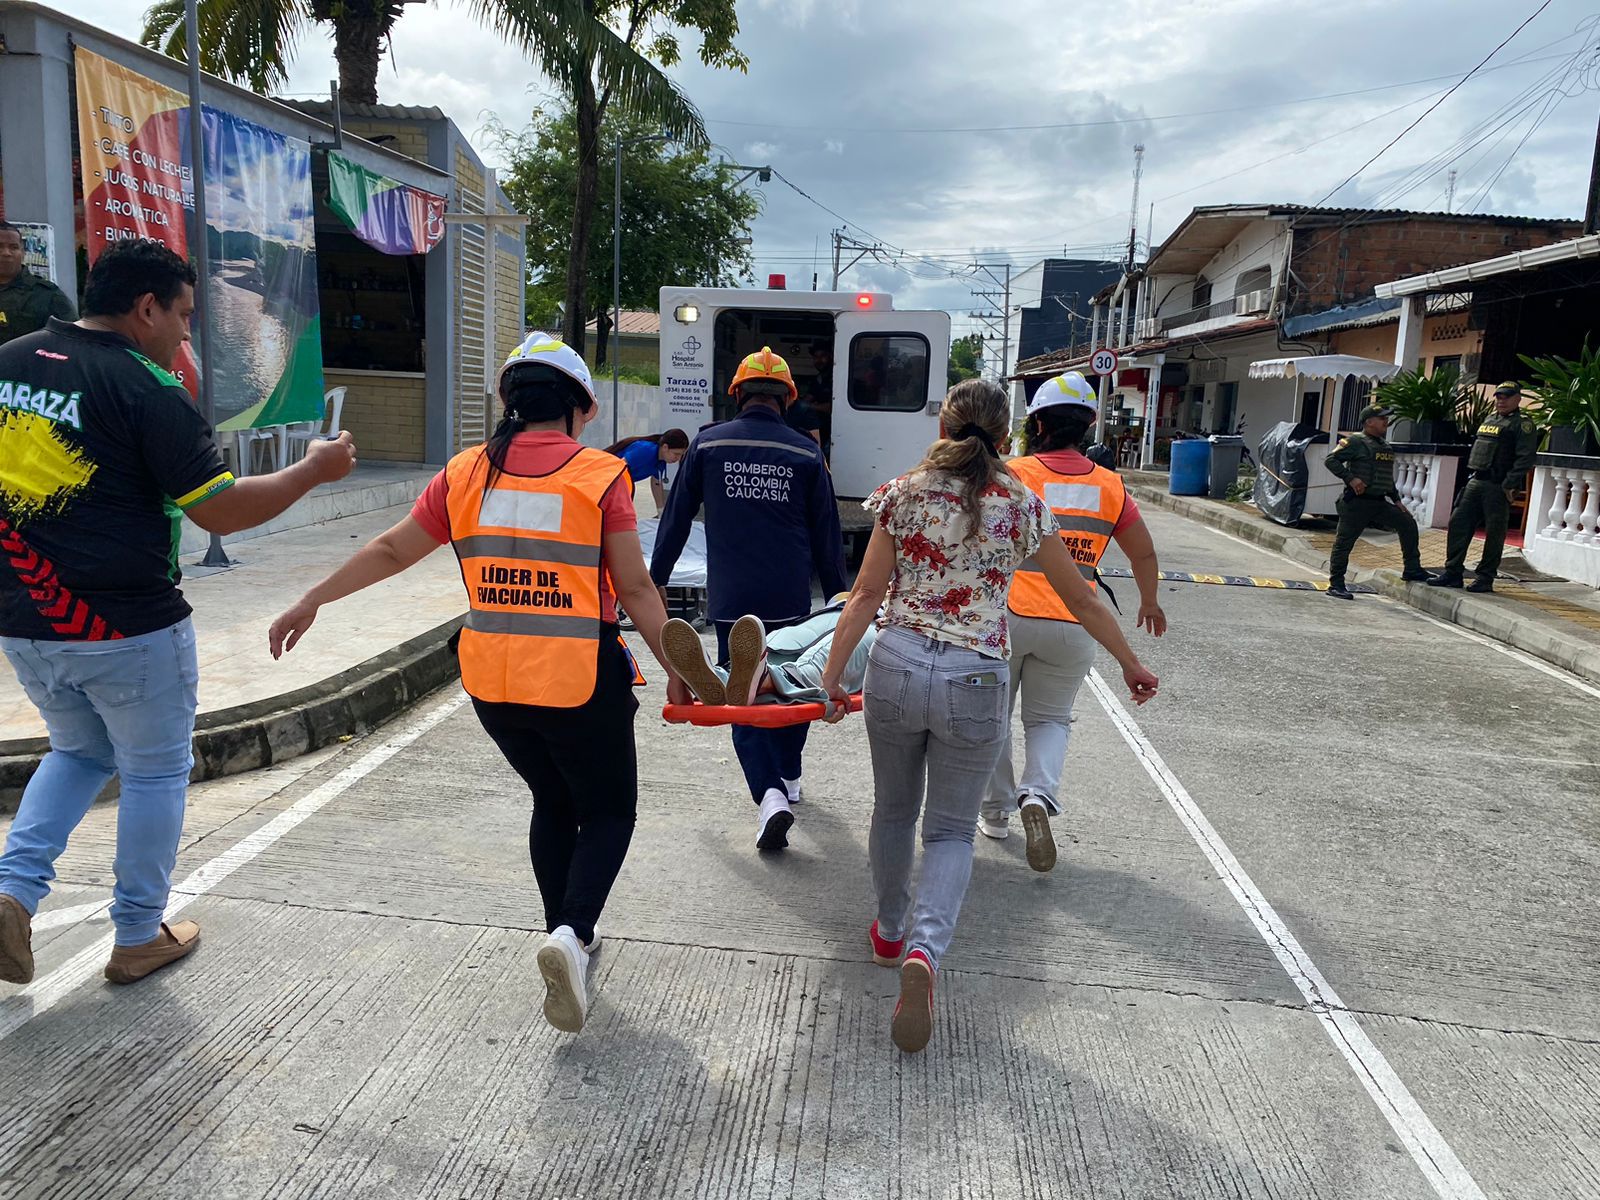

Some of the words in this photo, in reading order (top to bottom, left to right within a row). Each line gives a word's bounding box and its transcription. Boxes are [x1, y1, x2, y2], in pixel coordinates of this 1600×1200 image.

[132, 150, 157, 169] CON
[160, 160, 190, 180] LECHE
[104, 168, 139, 192] JUGOS
[143, 180, 195, 207] NATURALE
[1096, 356, 1112, 369] 30
[667, 377, 697, 386] Tarazá
[0, 382, 81, 430] ARAZÁ
[724, 461, 794, 478] BOMBEROS
[724, 474, 791, 491] COLOMBIA
[726, 486, 790, 503] CAUCASIA
[1081, 538, 1094, 550] DE
[482, 563, 532, 586] LÍDER
[537, 570, 560, 588] DE
[477, 587, 573, 609] EVACUACIÓN
